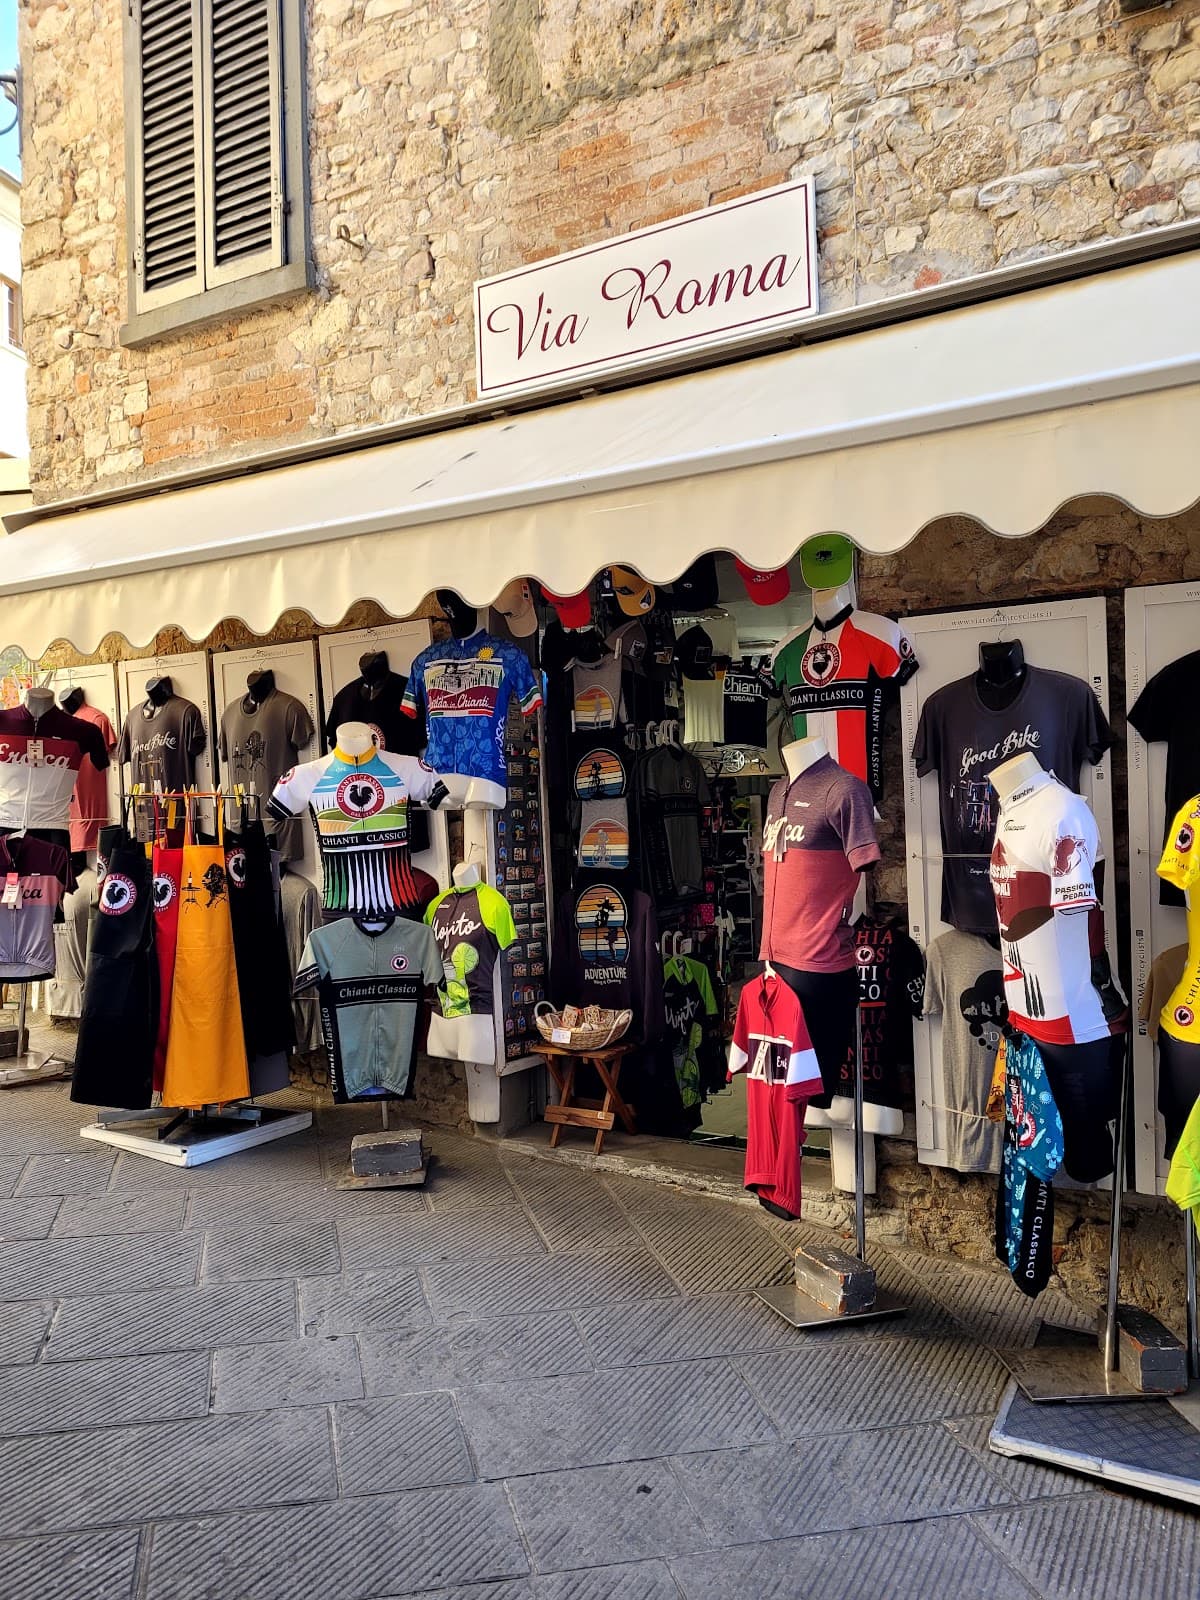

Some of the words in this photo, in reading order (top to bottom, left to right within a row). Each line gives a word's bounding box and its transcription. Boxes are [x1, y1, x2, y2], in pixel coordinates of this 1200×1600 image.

[487, 292, 588, 360] Via
[601, 254, 801, 330] Roma
[724, 677, 761, 694] Chianti
[821, 690, 864, 701] CLASSICO
[457, 693, 491, 709] Chianti
[872, 688, 881, 732] CHIANTI
[151, 731, 176, 751] Bike
[960, 743, 1000, 777] Good
[1000, 724, 1041, 759] Bike
[0, 743, 70, 769] Eroca
[872, 736, 880, 787] CLASSICO
[338, 776, 356, 802] CHIANTI
[360, 775, 384, 800] CLASSICO
[1012, 786, 1034, 801] Santini
[322, 836, 358, 846] CHIANTI
[366, 831, 406, 842] CLASSICO
[1063, 891, 1091, 901] PEDALI
[584, 967, 627, 980] ADVENTURE
[340, 985, 376, 998] Chianti
[377, 984, 417, 995] Classico
[322, 1008, 333, 1050] Classico
[328, 1054, 339, 1093] Chianti
[1026, 1216, 1042, 1279] CLASSICO
